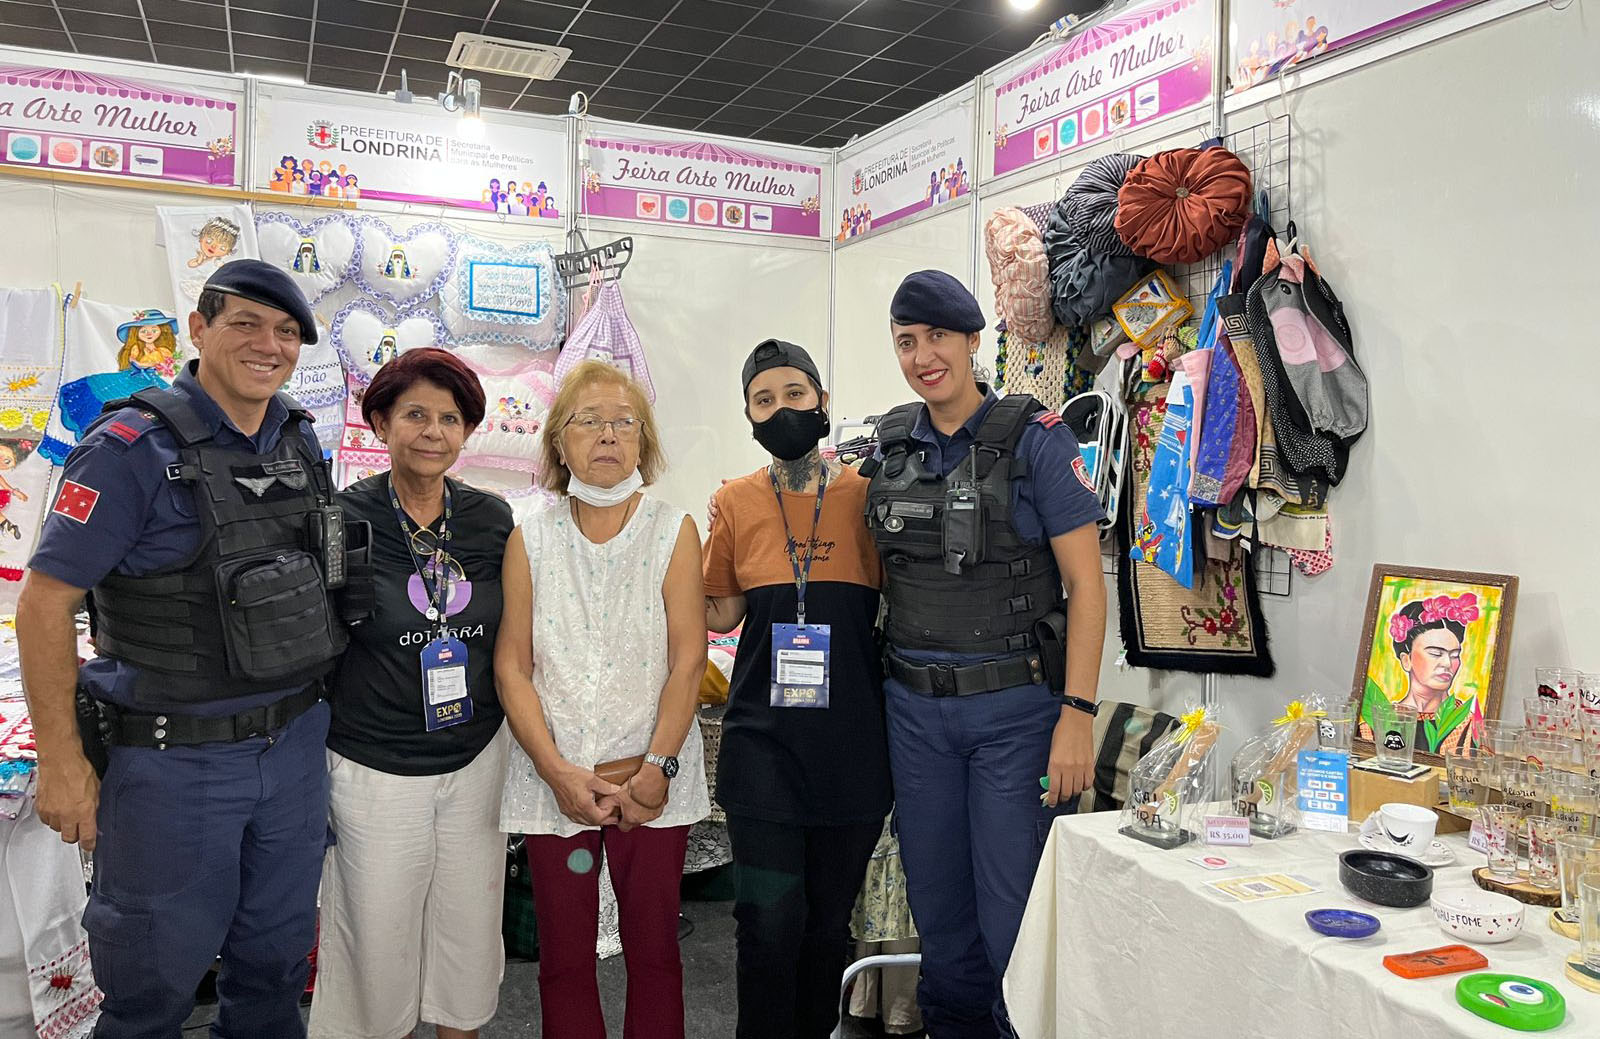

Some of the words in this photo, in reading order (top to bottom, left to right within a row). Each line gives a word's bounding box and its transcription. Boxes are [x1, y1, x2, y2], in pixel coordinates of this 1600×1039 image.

[1016, 85, 1060, 125] Feira
[1066, 66, 1103, 99] Arte
[1110, 30, 1184, 80] Mulher
[22, 97, 82, 124] Arte
[94, 103, 198, 137] Mulher
[340, 124, 424, 145] PREFEITURA
[425, 135, 443, 147] DE
[450, 139, 491, 152] Secretaria
[341, 137, 443, 162] LONDRINA
[450, 148, 488, 160] Municipal
[489, 153, 500, 161] de
[501, 153, 535, 165] Políticas
[864, 151, 900, 175] PREFEITURA
[899, 147, 908, 159] DE
[482, 160, 518, 171] Mulheres
[864, 161, 908, 191] LONDRINA
[612, 158, 669, 183] Feira
[676, 166, 718, 189] Arte
[725, 171, 796, 197] Mulher
[295, 371, 327, 390] João
[784, 687, 817, 698] EXPO
[436, 702, 462, 718] EXPO
